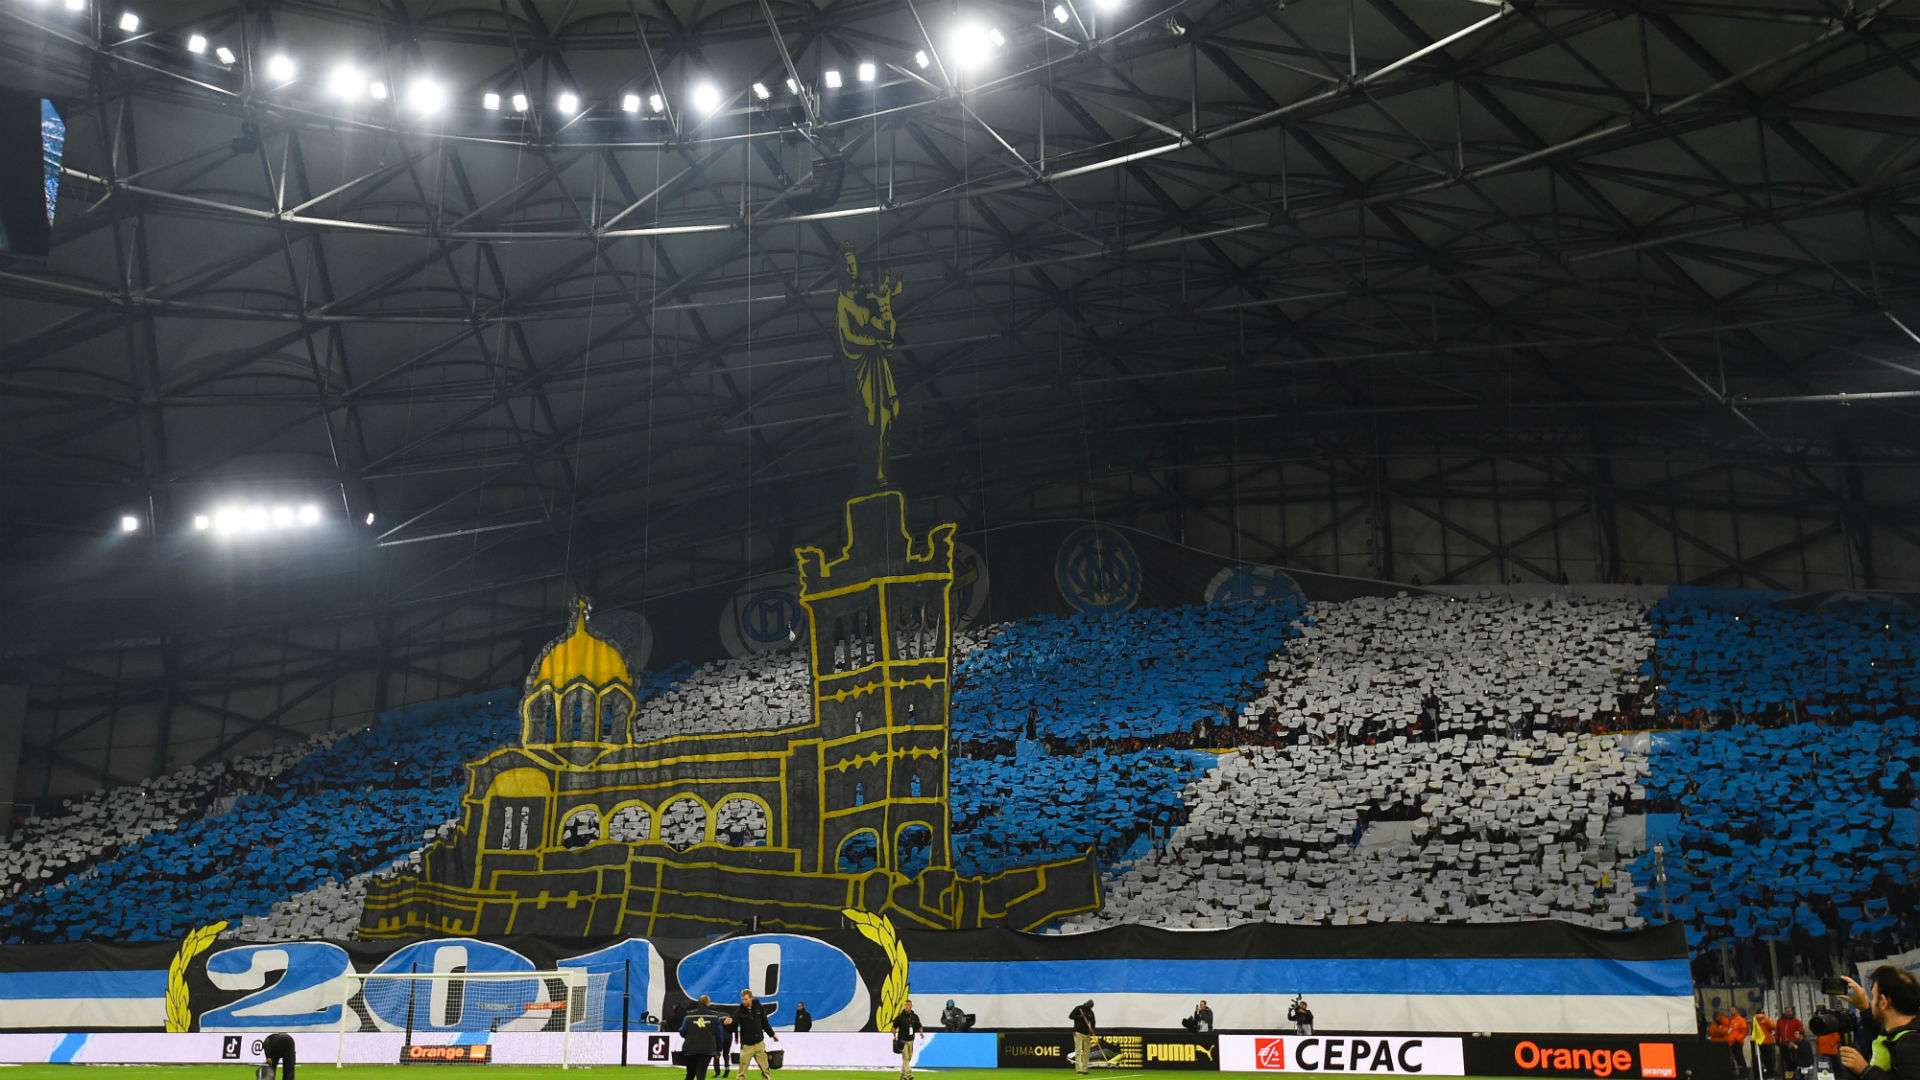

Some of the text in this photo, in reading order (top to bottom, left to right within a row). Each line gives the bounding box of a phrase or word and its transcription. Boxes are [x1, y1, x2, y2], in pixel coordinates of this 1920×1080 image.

[410, 1046, 464, 1060] Orange
[1146, 1044, 1196, 1062] PUMA
[1295, 1038, 1423, 1073] CEPAC
[1514, 1040, 1632, 1077] Orange
[1642, 1067, 1673, 1077] orange
